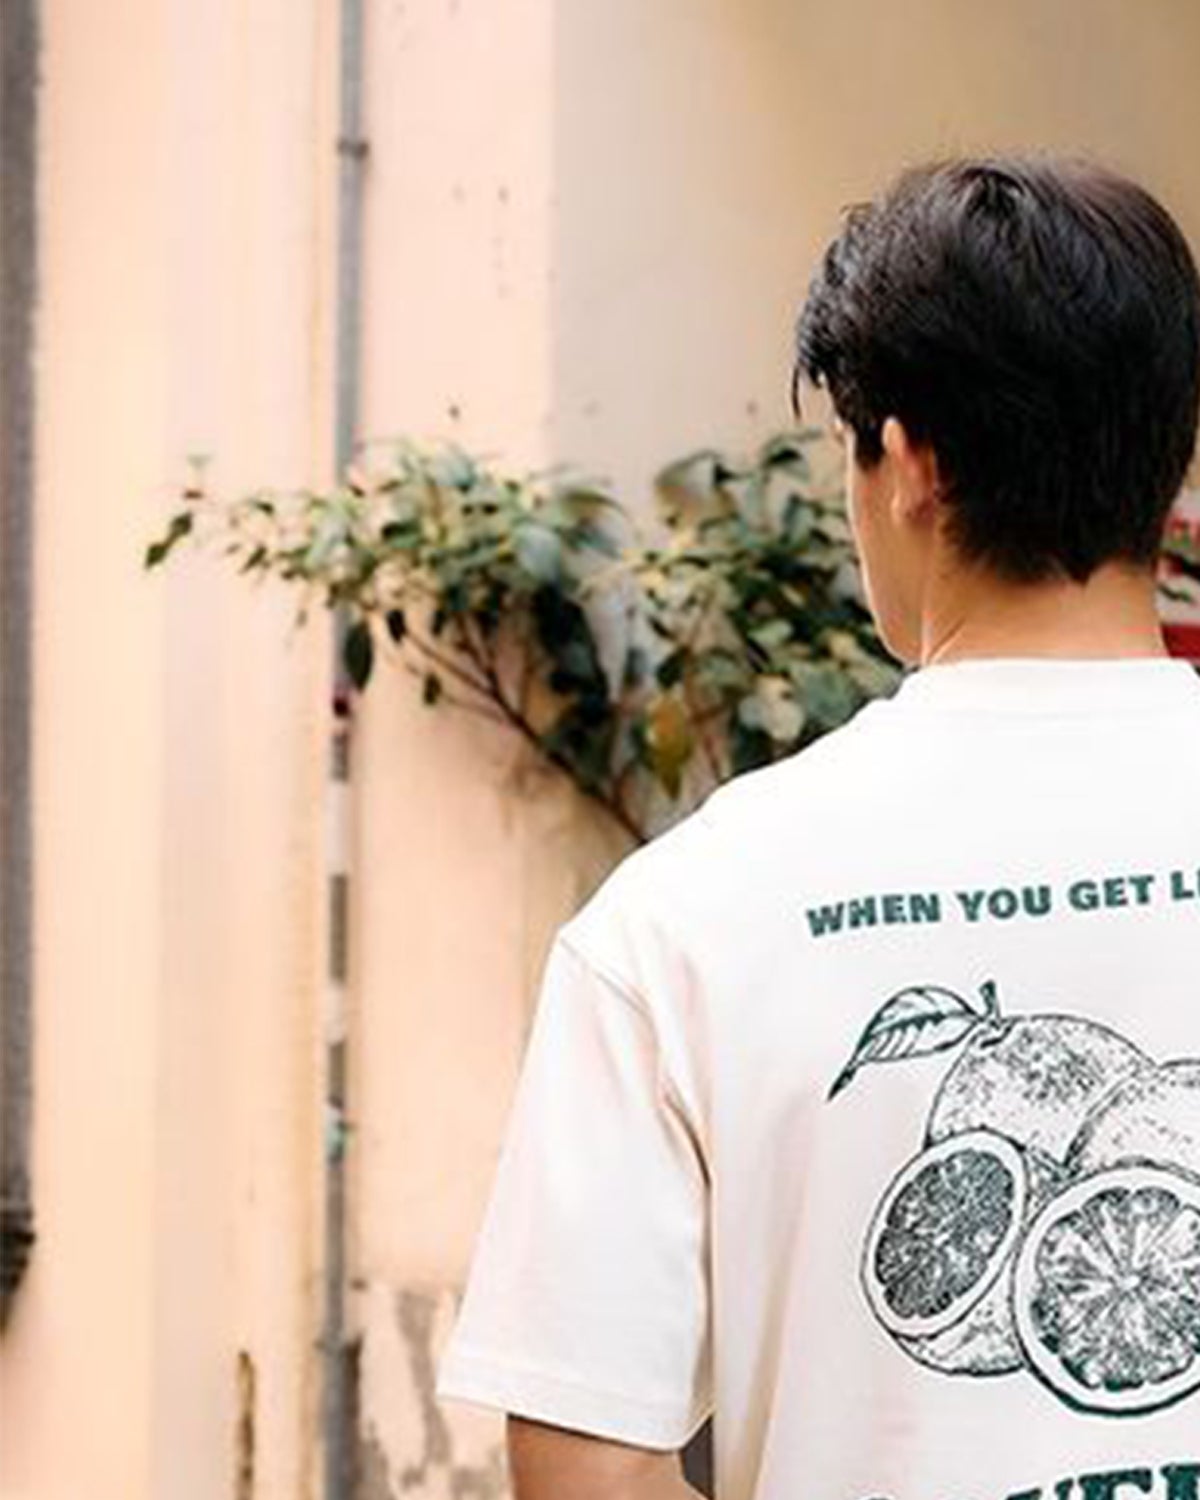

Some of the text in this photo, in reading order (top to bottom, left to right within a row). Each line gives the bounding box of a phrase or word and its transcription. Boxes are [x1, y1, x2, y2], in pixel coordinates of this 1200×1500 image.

[807, 893, 941, 938] WHEN
[957, 885, 1051, 922] YOU
[1069, 874, 1155, 911] GET
